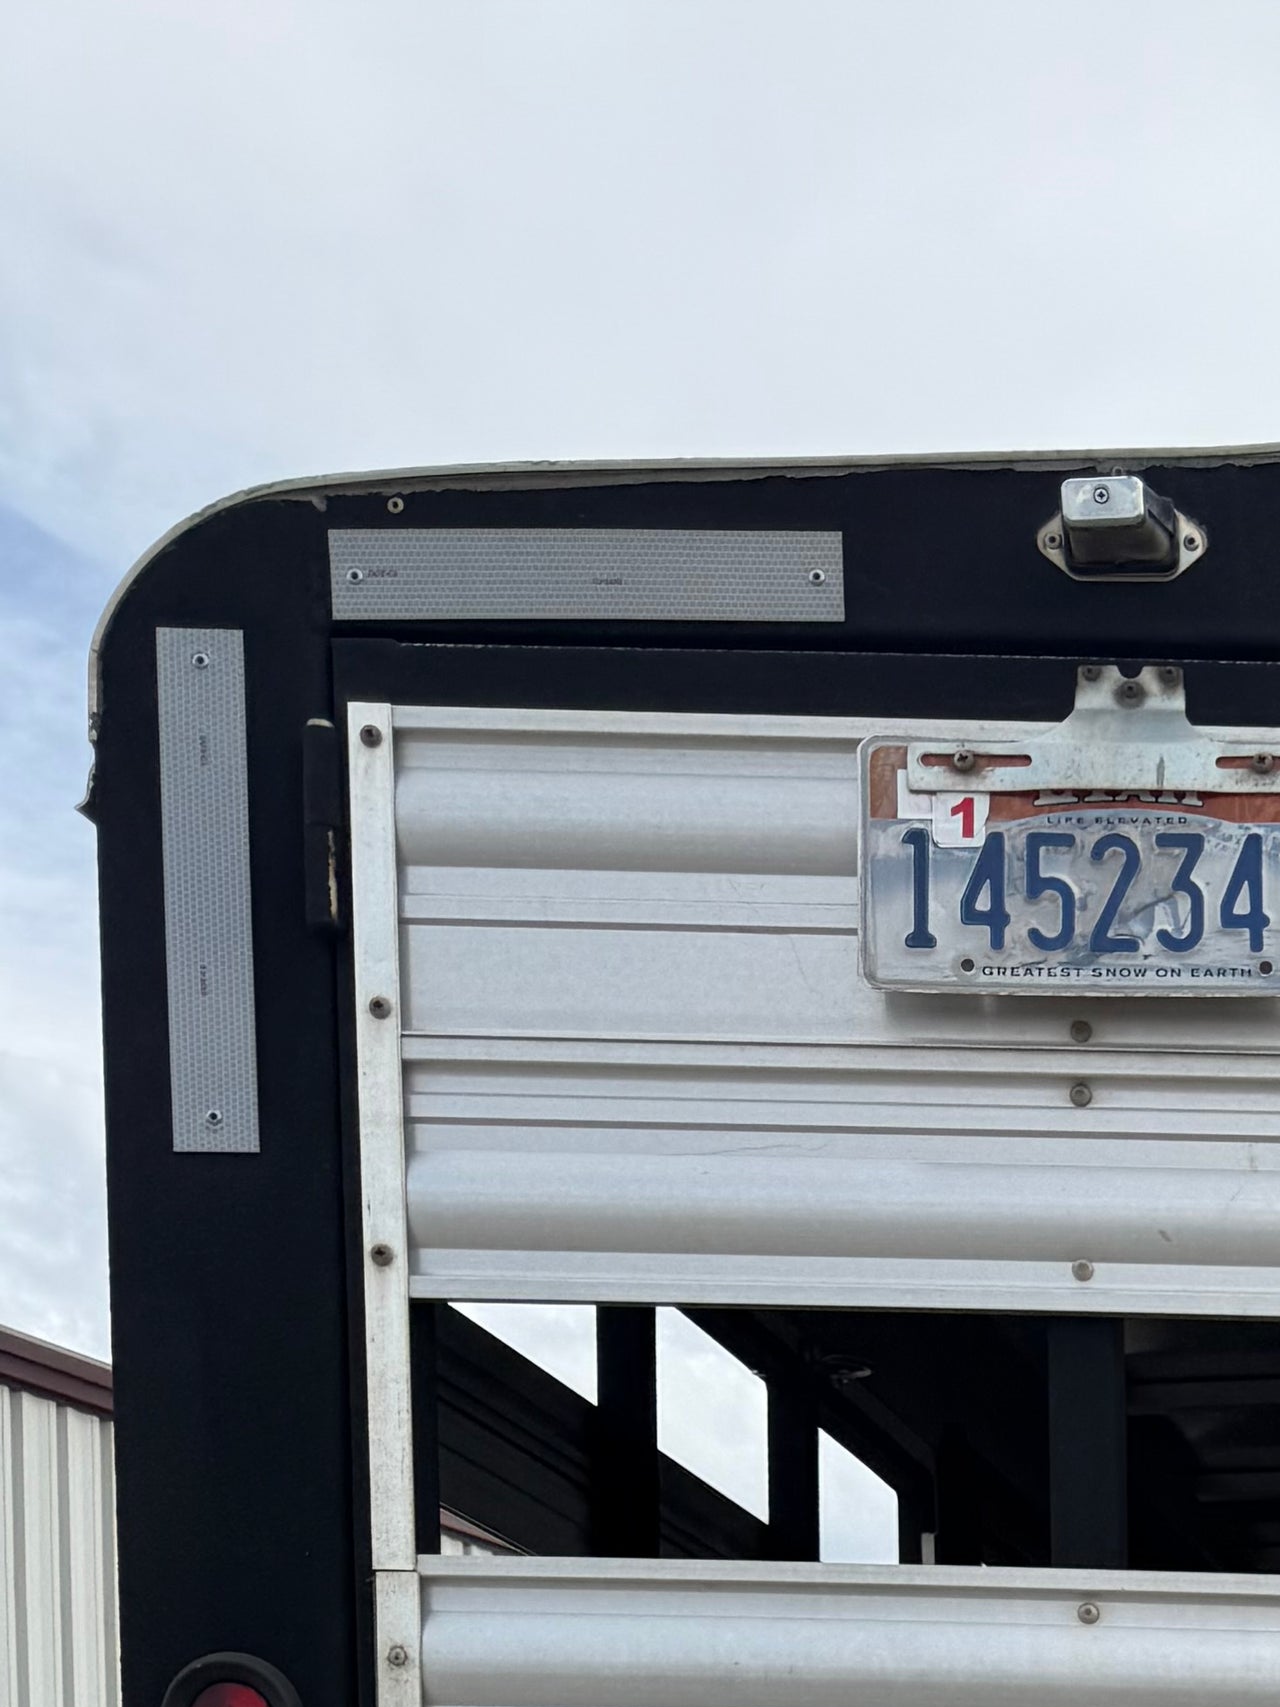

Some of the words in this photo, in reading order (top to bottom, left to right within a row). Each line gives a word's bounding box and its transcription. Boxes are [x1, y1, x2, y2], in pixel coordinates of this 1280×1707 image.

[951, 797, 974, 838] 1
[1095, 816, 1188, 825] ELEVATED
[982, 966, 1083, 978] GREATEST
[1091, 967, 1148, 978] SNOW
[1155, 968, 1182, 978] ON
[1191, 968, 1252, 979] EARTH
